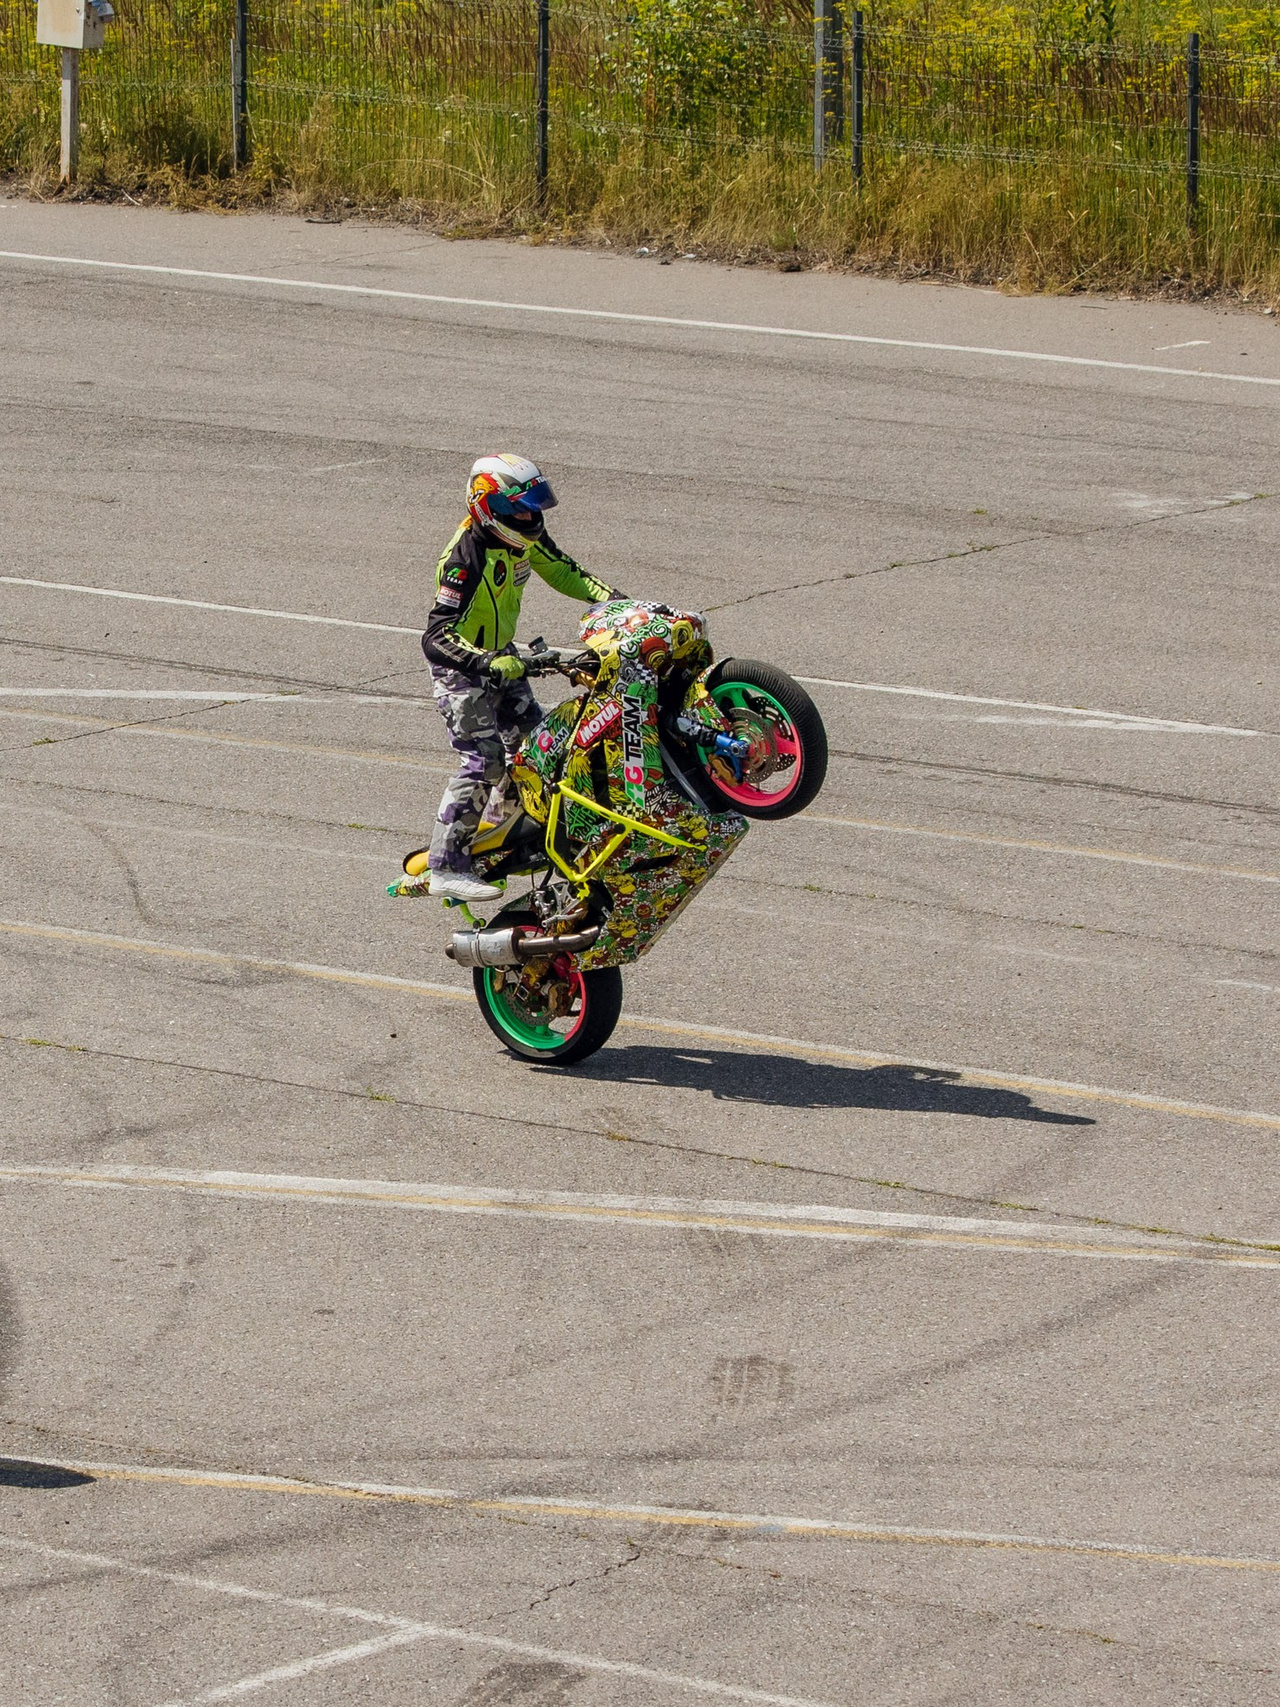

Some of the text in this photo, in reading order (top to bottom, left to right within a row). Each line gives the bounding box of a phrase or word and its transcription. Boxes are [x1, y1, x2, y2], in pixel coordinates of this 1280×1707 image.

[446, 576, 463, 585] TEAM
[579, 702, 619, 743] MOTUL
[623, 695, 642, 762] TEAM
[548, 728, 569, 755] TEAM
